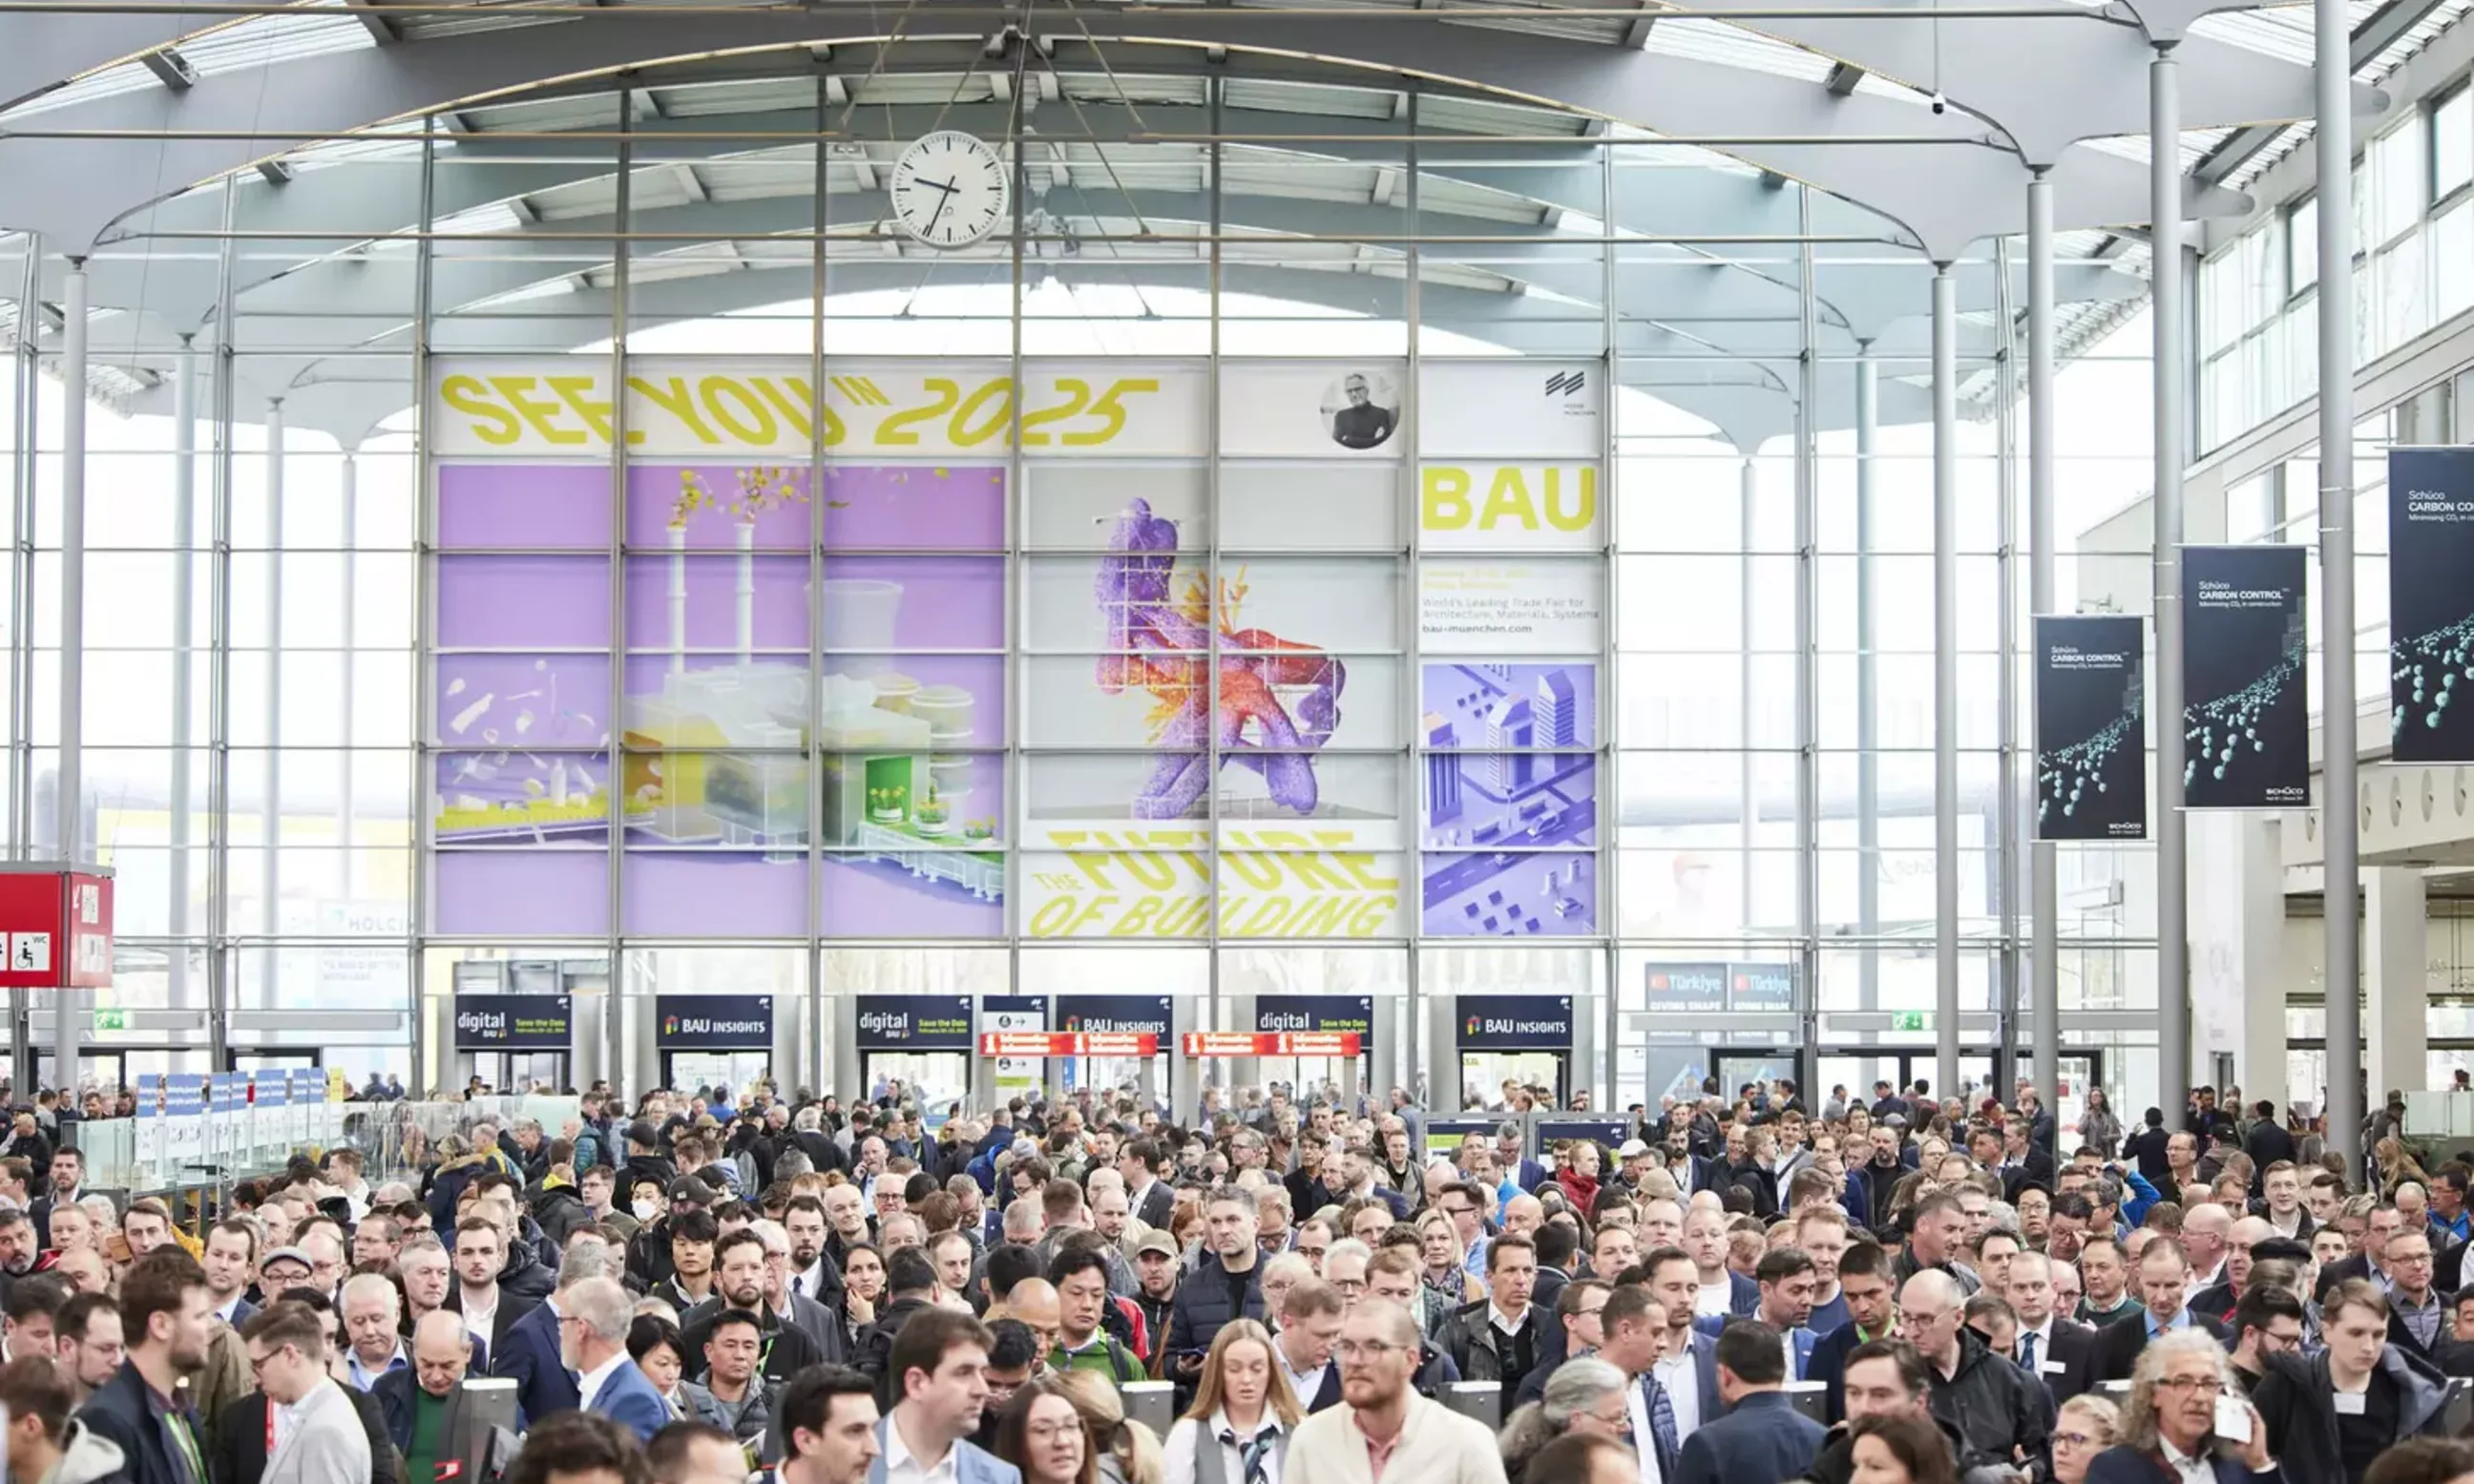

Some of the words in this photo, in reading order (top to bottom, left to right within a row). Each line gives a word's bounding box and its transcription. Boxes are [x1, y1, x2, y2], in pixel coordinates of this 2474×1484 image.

[441, 375, 646, 445] SEE
[626, 375, 847, 446] YOU
[829, 376, 891, 406] IN
[874, 377, 1159, 447] 2025
[1422, 468, 1596, 532] BAU
[2408, 490, 2445, 500] Schüco
[2408, 502, 2455, 512] CARBON
[2457, 502, 2474, 512] CO
[1466, 597, 1509, 609] Leading
[1512, 597, 1541, 607] Trade
[1545, 597, 1565, 607] Fair
[1569, 597, 1583, 607] for
[2198, 591, 2238, 599] CARBON
[2239, 591, 2283, 599] CONTROL
[1552, 610, 1600, 620] Systems
[1422, 624, 1533, 634] bau-muenchen.com
[2050, 654, 2085, 662] CARBON
[2086, 654, 2124, 662] CONTROL
[1046, 830, 1399, 891] FUTURE
[1031, 873, 1087, 891] THE
[349, 916, 405, 931] HOLCI
[1030, 895, 1121, 937] OF
[1106, 895, 1398, 937] BUILDING
[32, 935, 47, 944] WC
[1668, 973, 1723, 995] Türkiye
[1749, 973, 1791, 995] Türkiye
[457, 1012, 506, 1033] digital
[681, 1018, 711, 1033] BAU
[713, 1021, 765, 1034] INSIGHTS
[859, 1012, 908, 1033] digital
[1083, 1018, 1112, 1032] BAU
[1114, 1020, 1166, 1034] INSIGHTS
[1260, 1012, 1310, 1033] digital
[1485, 1018, 1514, 1033] BAU
[1516, 1021, 1566, 1034] INSIGHTS
